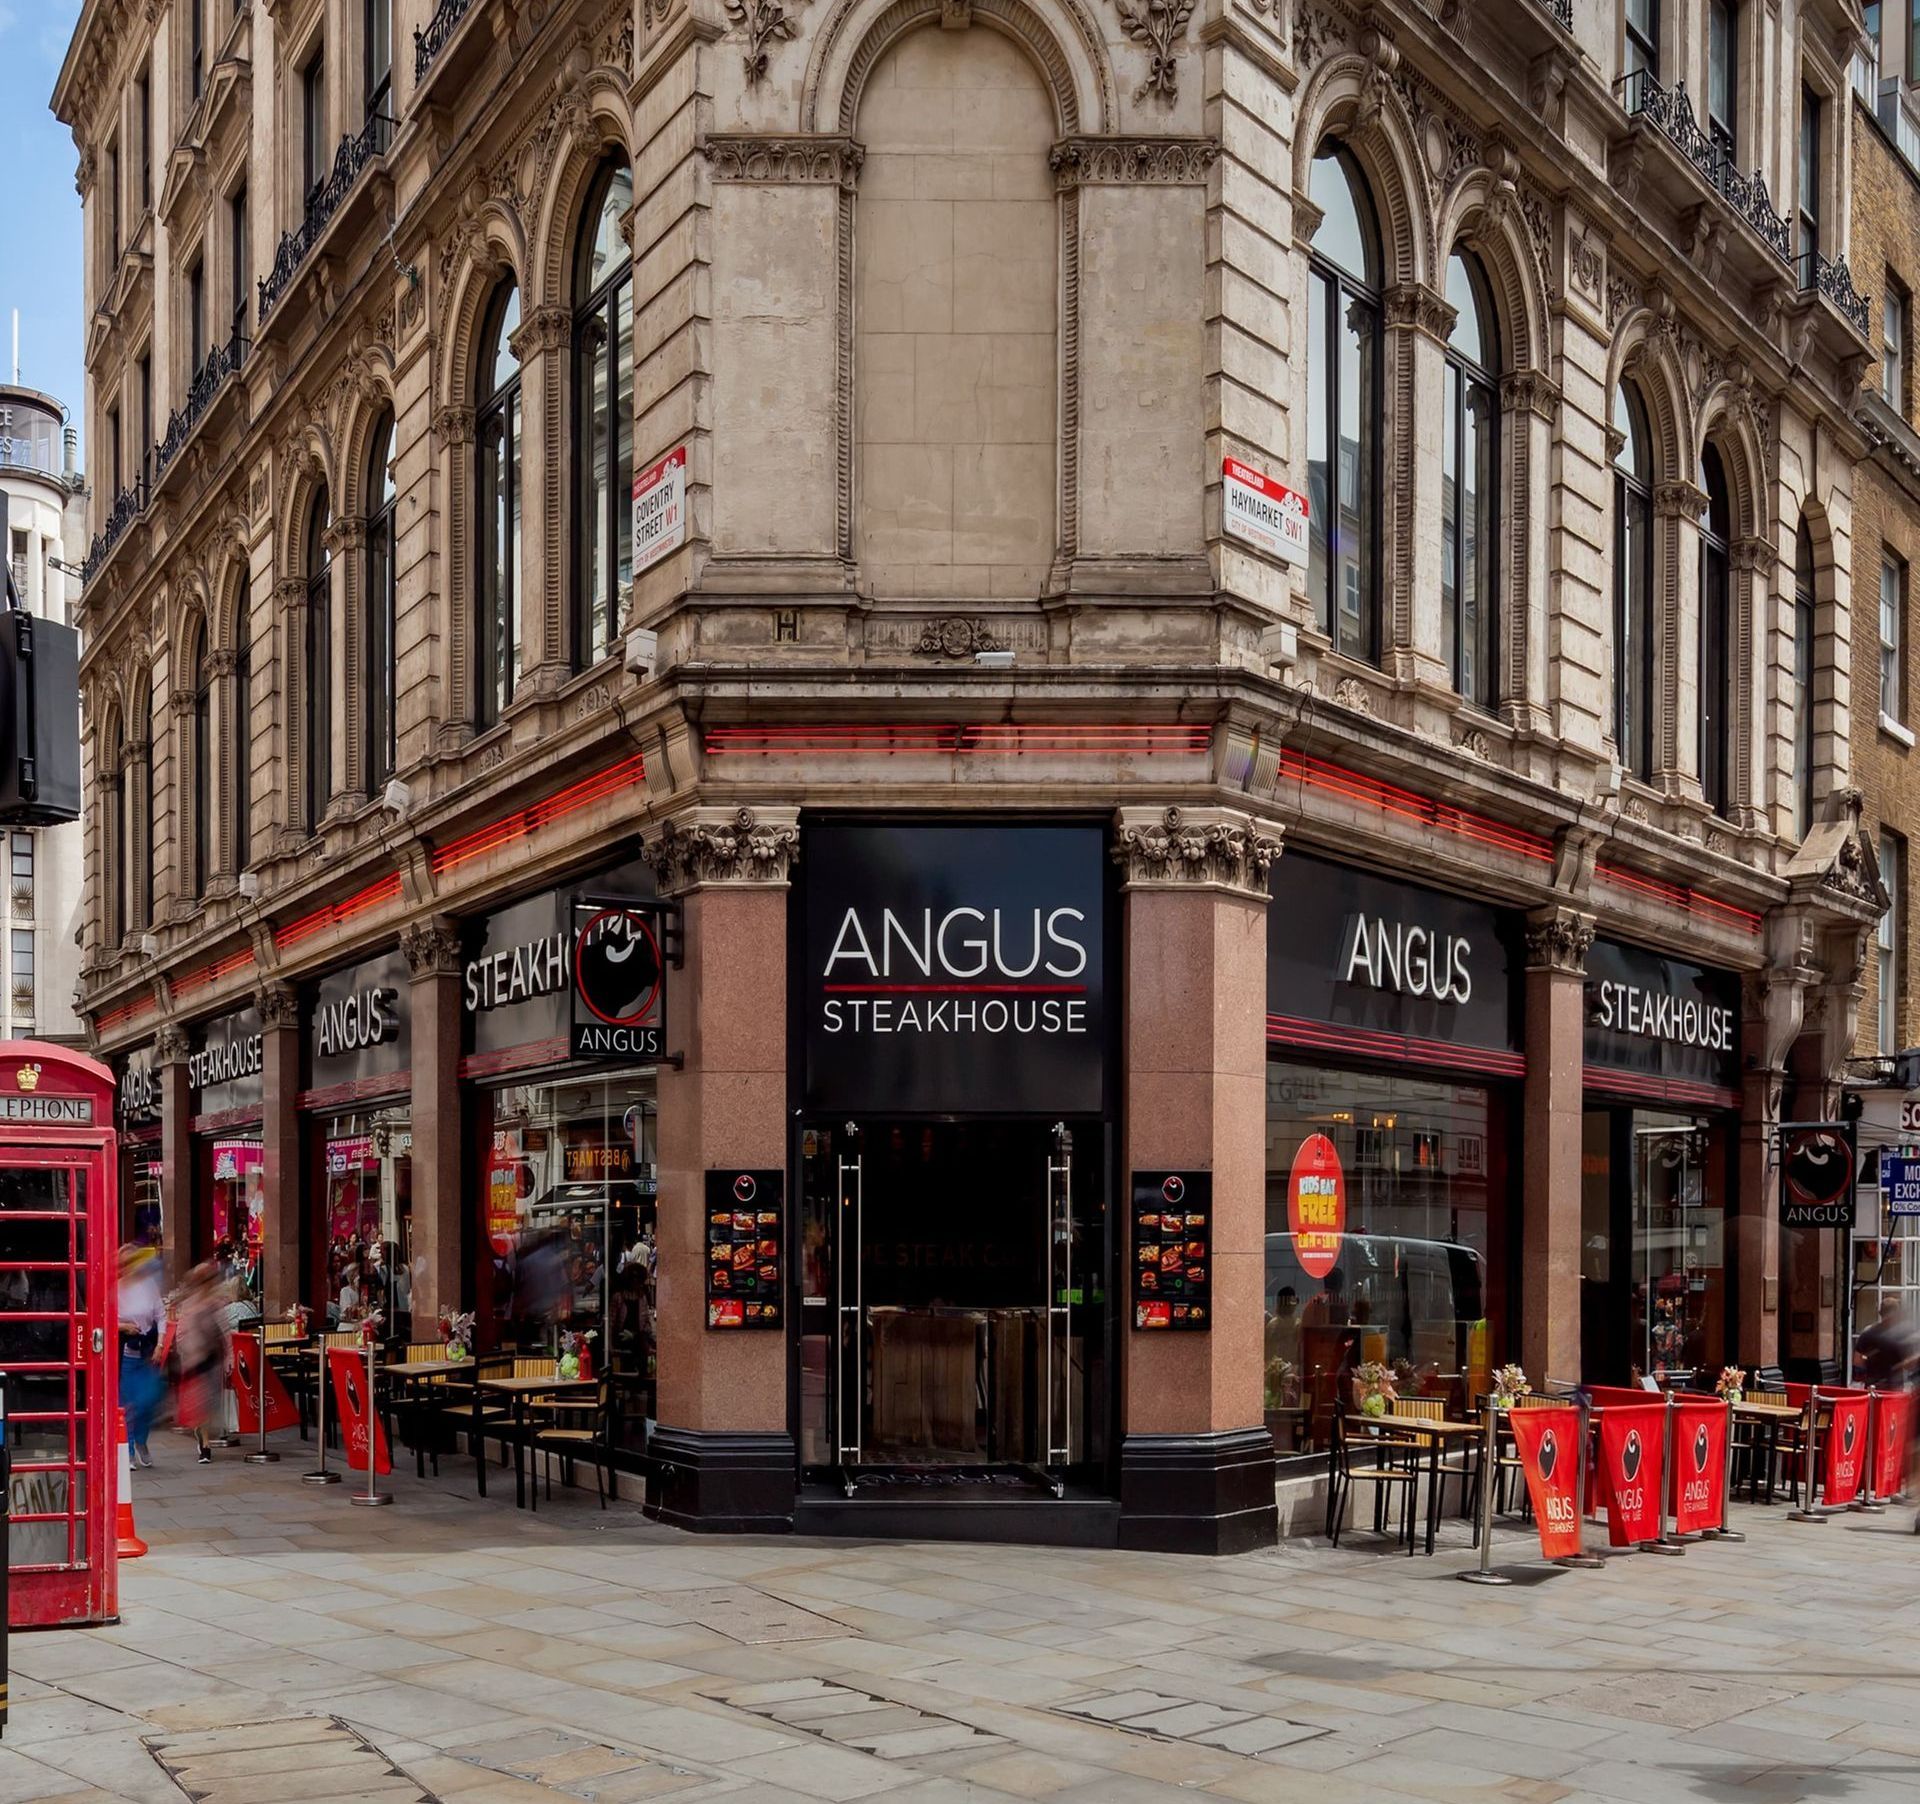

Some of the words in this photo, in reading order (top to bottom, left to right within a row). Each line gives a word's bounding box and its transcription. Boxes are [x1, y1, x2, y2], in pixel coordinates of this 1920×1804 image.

[636, 481, 675, 524] COVENTRY
[1231, 488, 1284, 531] HAYMARKET
[1285, 518, 1303, 542] SW1
[636, 513, 664, 548] STREET
[665, 503, 678, 527] W1
[777, 610, 798, 642] H
[824, 907, 1087, 978] ANGUS
[1346, 912, 1472, 1005] ANGUS
[318, 988, 383, 1057] ANGUS
[823, 1001, 1087, 1033] STEAKHOUSE
[1600, 980, 1733, 1051] STEAKHOUSE
[188, 1034, 262, 1090] STEAKHOUSE
[579, 1028, 658, 1053] ANGUS
[0, 1098, 88, 1120] EPHONE
[121, 1068, 153, 1111] ANGUS
[1299, 1175, 1320, 1195] KIDS
[1320, 1178, 1336, 1195] EAT
[1298, 1195, 1337, 1225] FREE
[1786, 1206, 1849, 1222] ANGUS
[1683, 1479, 1710, 1501] ANGUS
